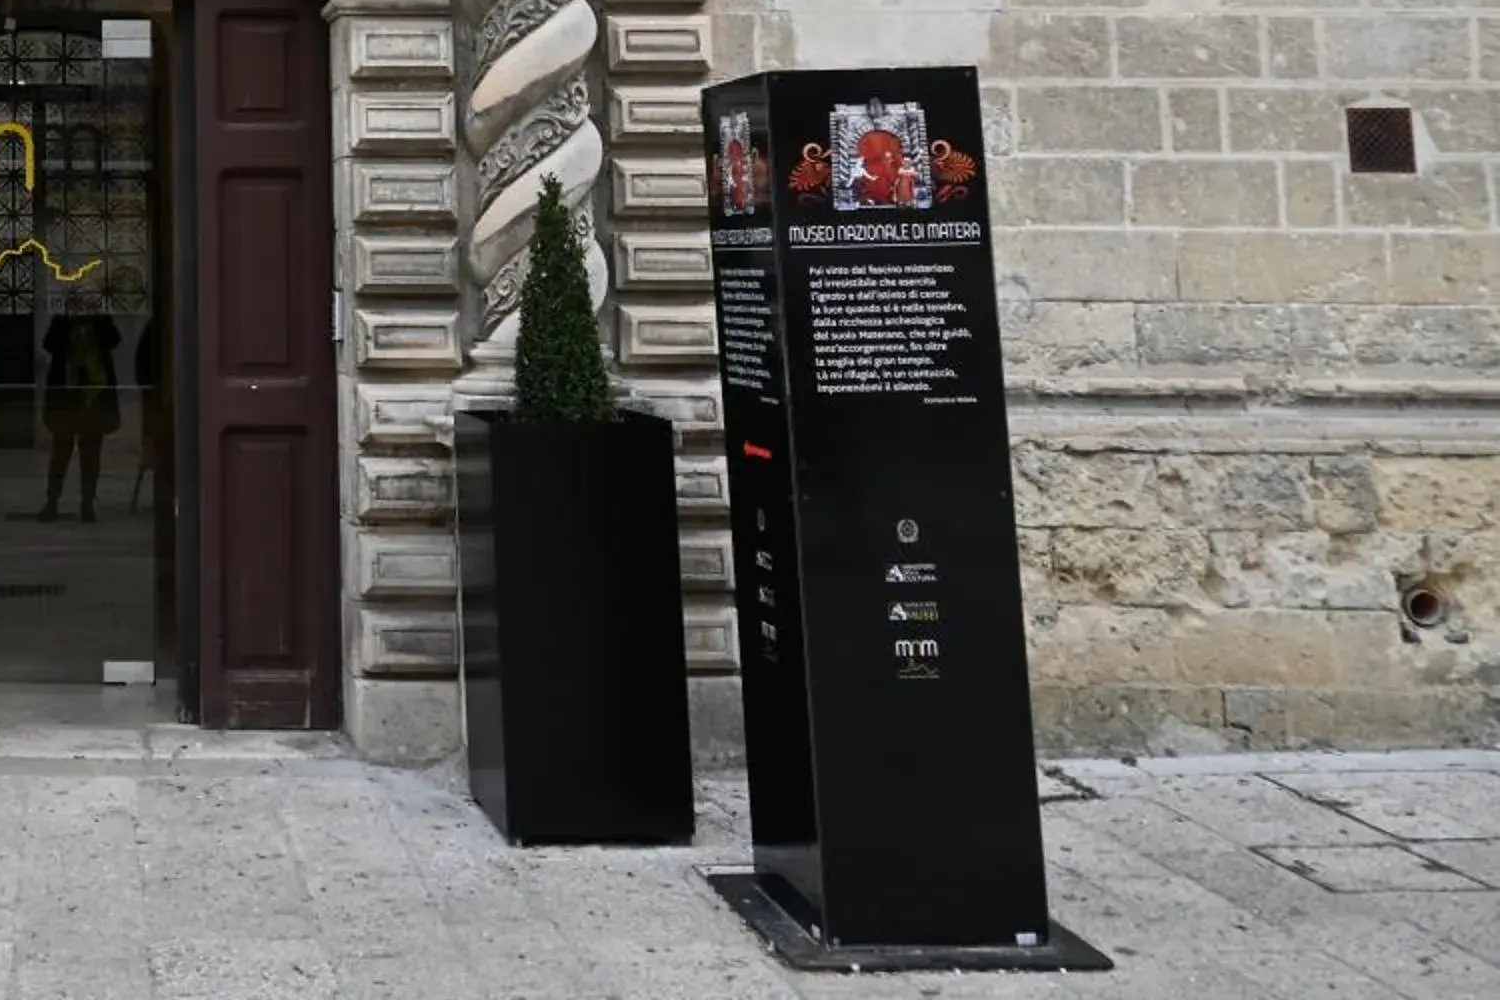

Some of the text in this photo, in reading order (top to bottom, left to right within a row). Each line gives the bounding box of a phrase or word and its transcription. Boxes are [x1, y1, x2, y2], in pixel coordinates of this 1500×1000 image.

[789, 224, 835, 243] MUSEO
[837, 223, 909, 241] NAZIONALE
[912, 223, 925, 240] DI
[928, 222, 981, 239] MATERA
[880, 278, 897, 287] che
[908, 289, 918, 299] di
[811, 305, 821, 314] la
[823, 304, 843, 314] luce
[845, 304, 881, 316] quando
[812, 317, 837, 327] dalla
[909, 330, 926, 339] che
[928, 328, 941, 338] mi
[815, 357, 825, 367] la
[830, 370, 842, 380] mi
[893, 370, 907, 379] un
